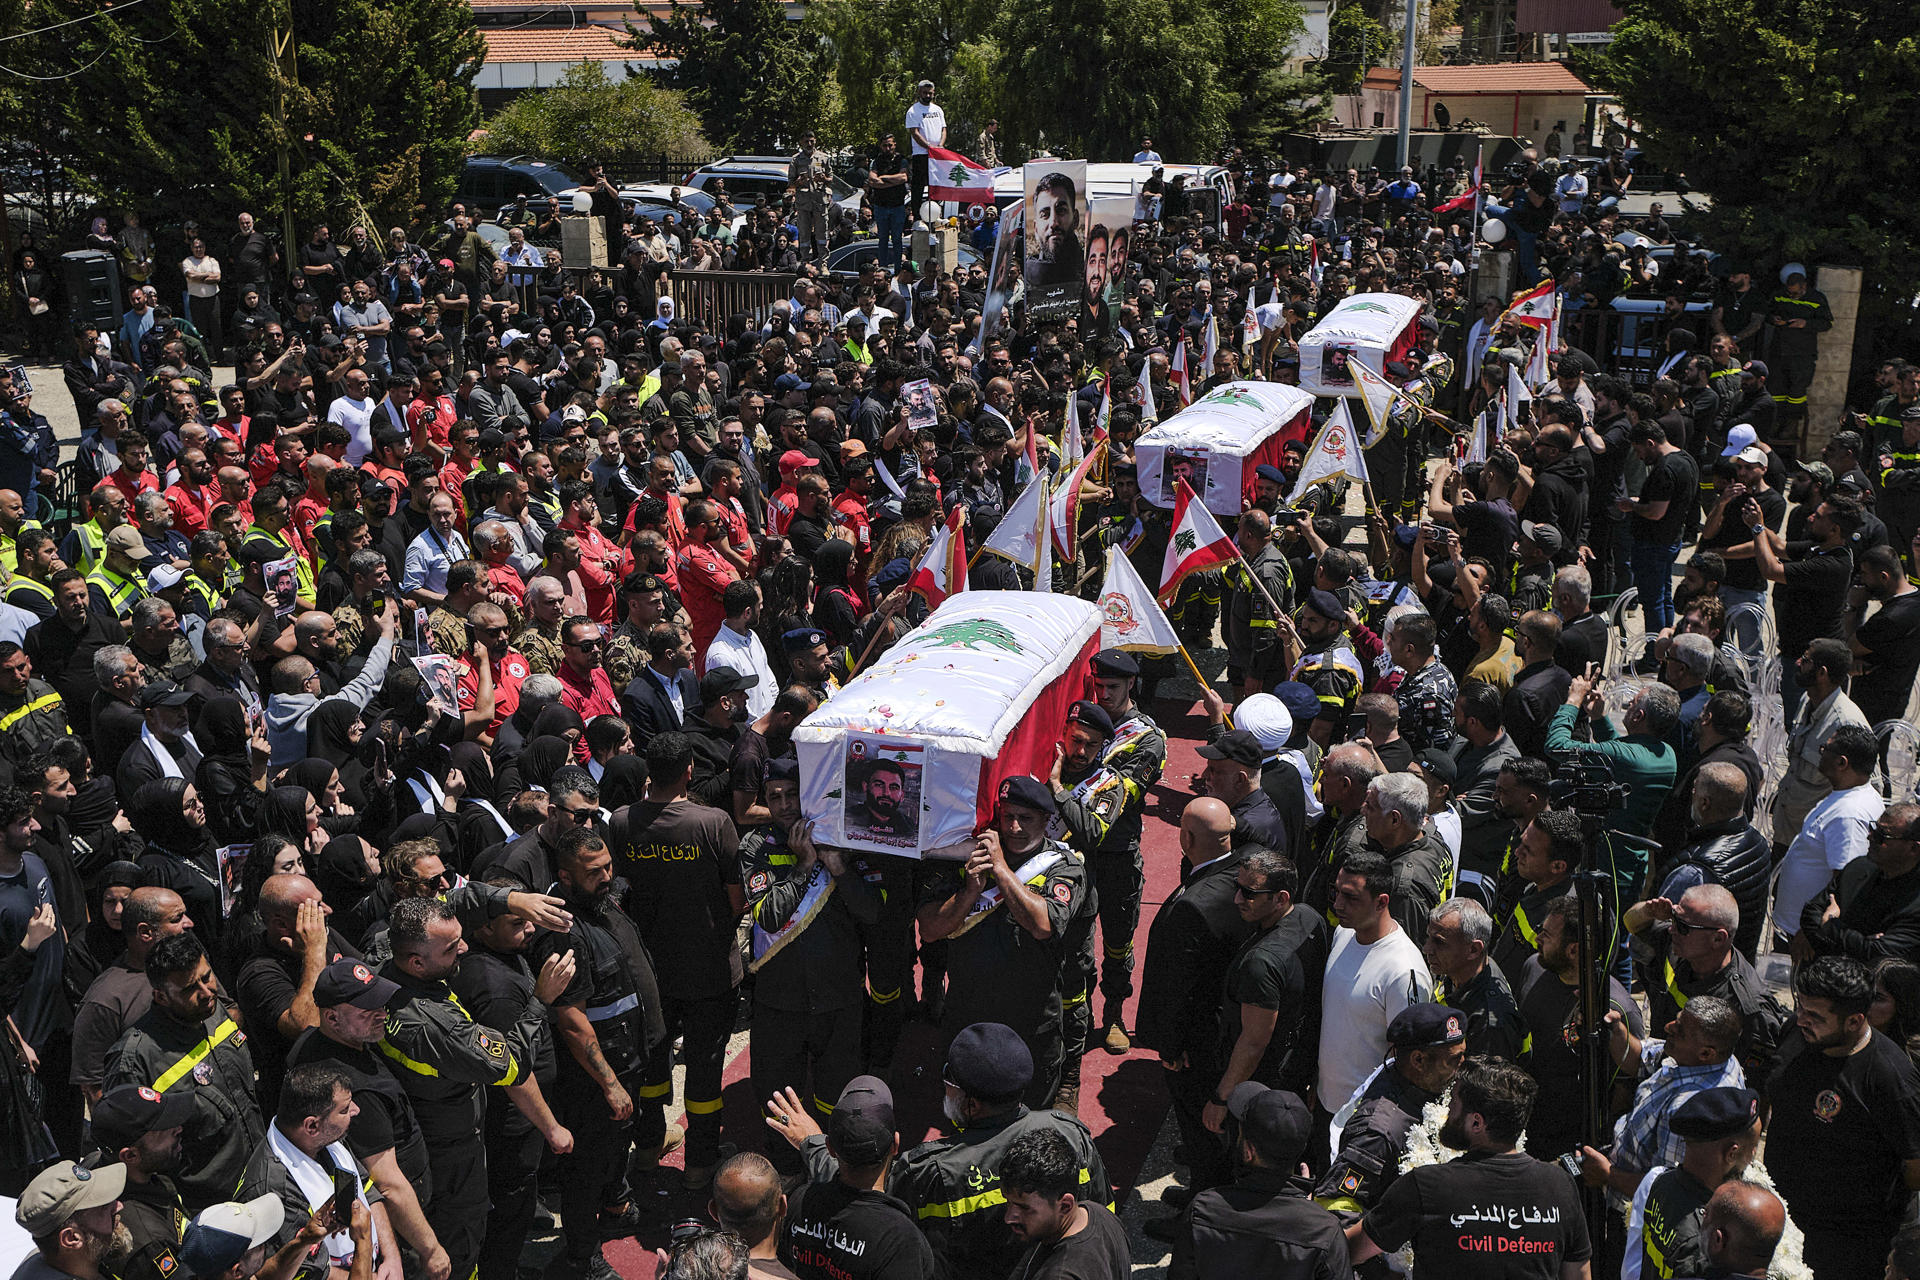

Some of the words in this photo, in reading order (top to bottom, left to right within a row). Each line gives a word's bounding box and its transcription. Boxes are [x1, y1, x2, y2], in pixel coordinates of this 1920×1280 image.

[1450, 1203, 1506, 1228] المدني
[1508, 1204, 1560, 1230] الدفاع
[791, 1218, 827, 1241] المدني
[826, 1228, 866, 1257] الدفاع
[1458, 1235, 1493, 1252] Civil
[1497, 1236, 1555, 1253] Defence
